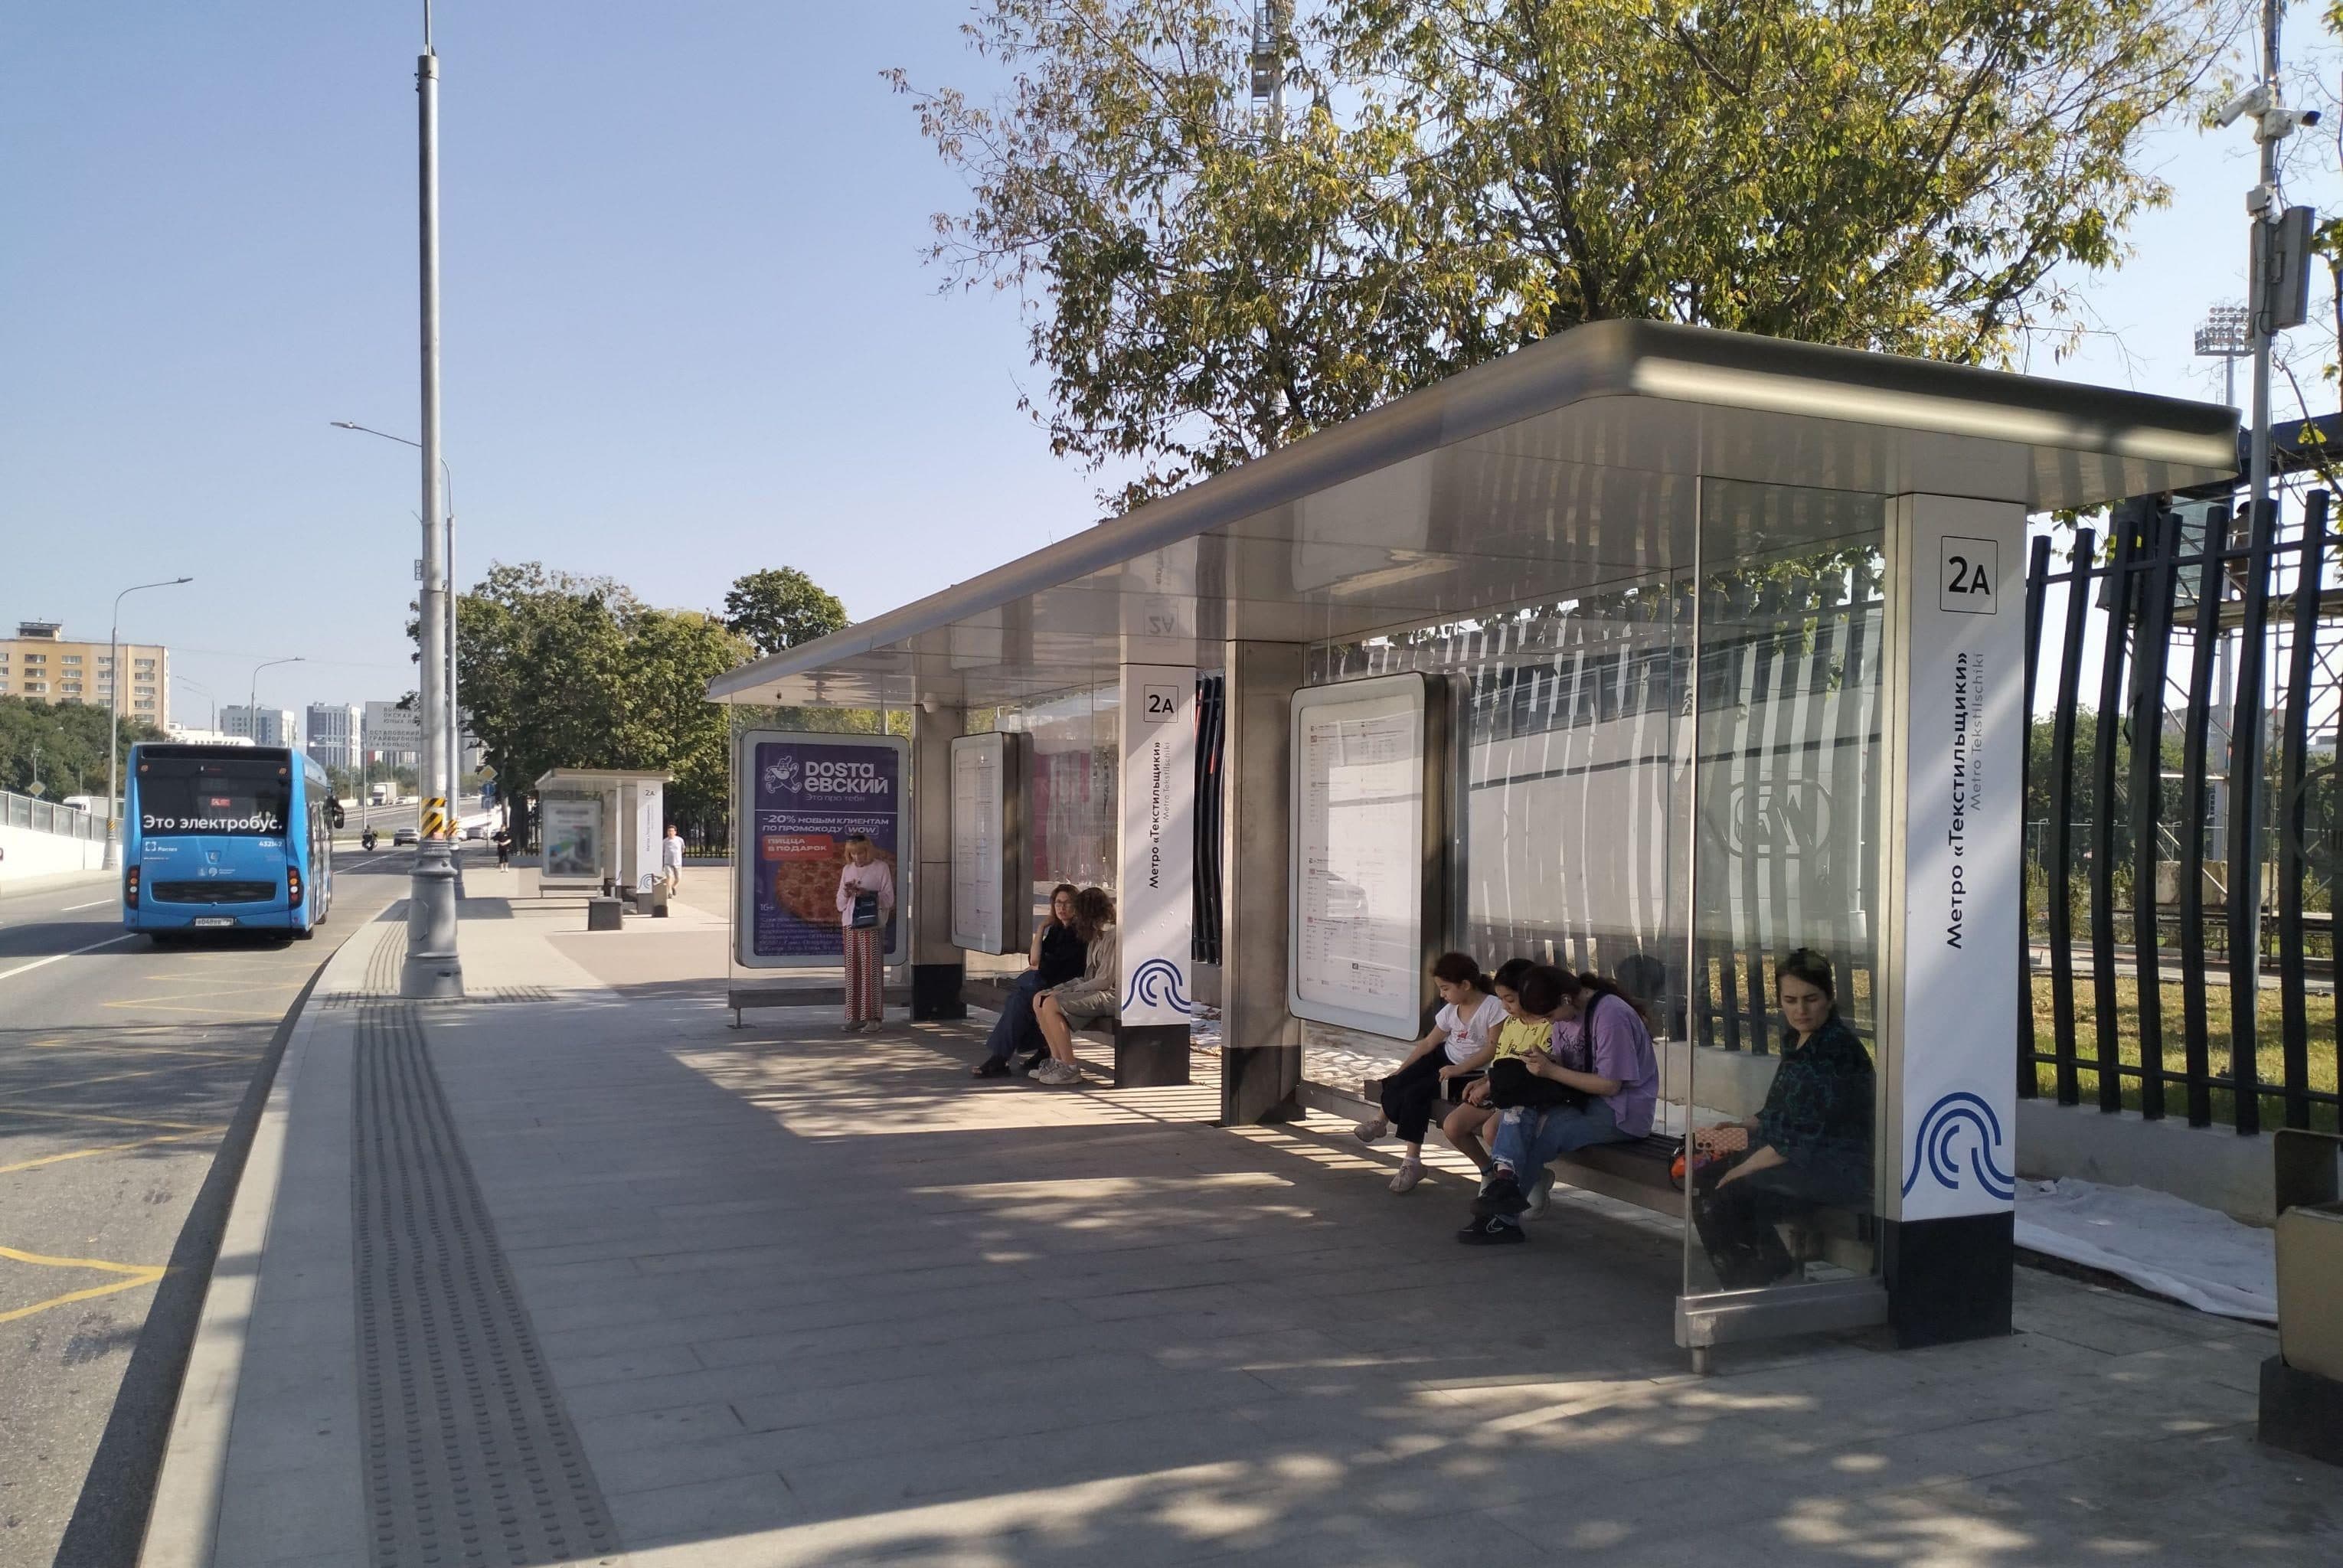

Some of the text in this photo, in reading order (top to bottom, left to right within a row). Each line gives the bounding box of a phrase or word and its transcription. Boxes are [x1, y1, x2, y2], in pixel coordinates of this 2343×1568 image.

[1971, 654, 1984, 811] Metro Tekstilschiki
[143, 812, 283, 832] Это электробус.
[763, 815, 796, 823] -20%
[778, 825, 843, 834] ПРОМОКОДУ
[1149, 742, 1161, 889] Метро «Текстильщики»
[1947, 652, 1969, 949] Метро «Текстильщики»
